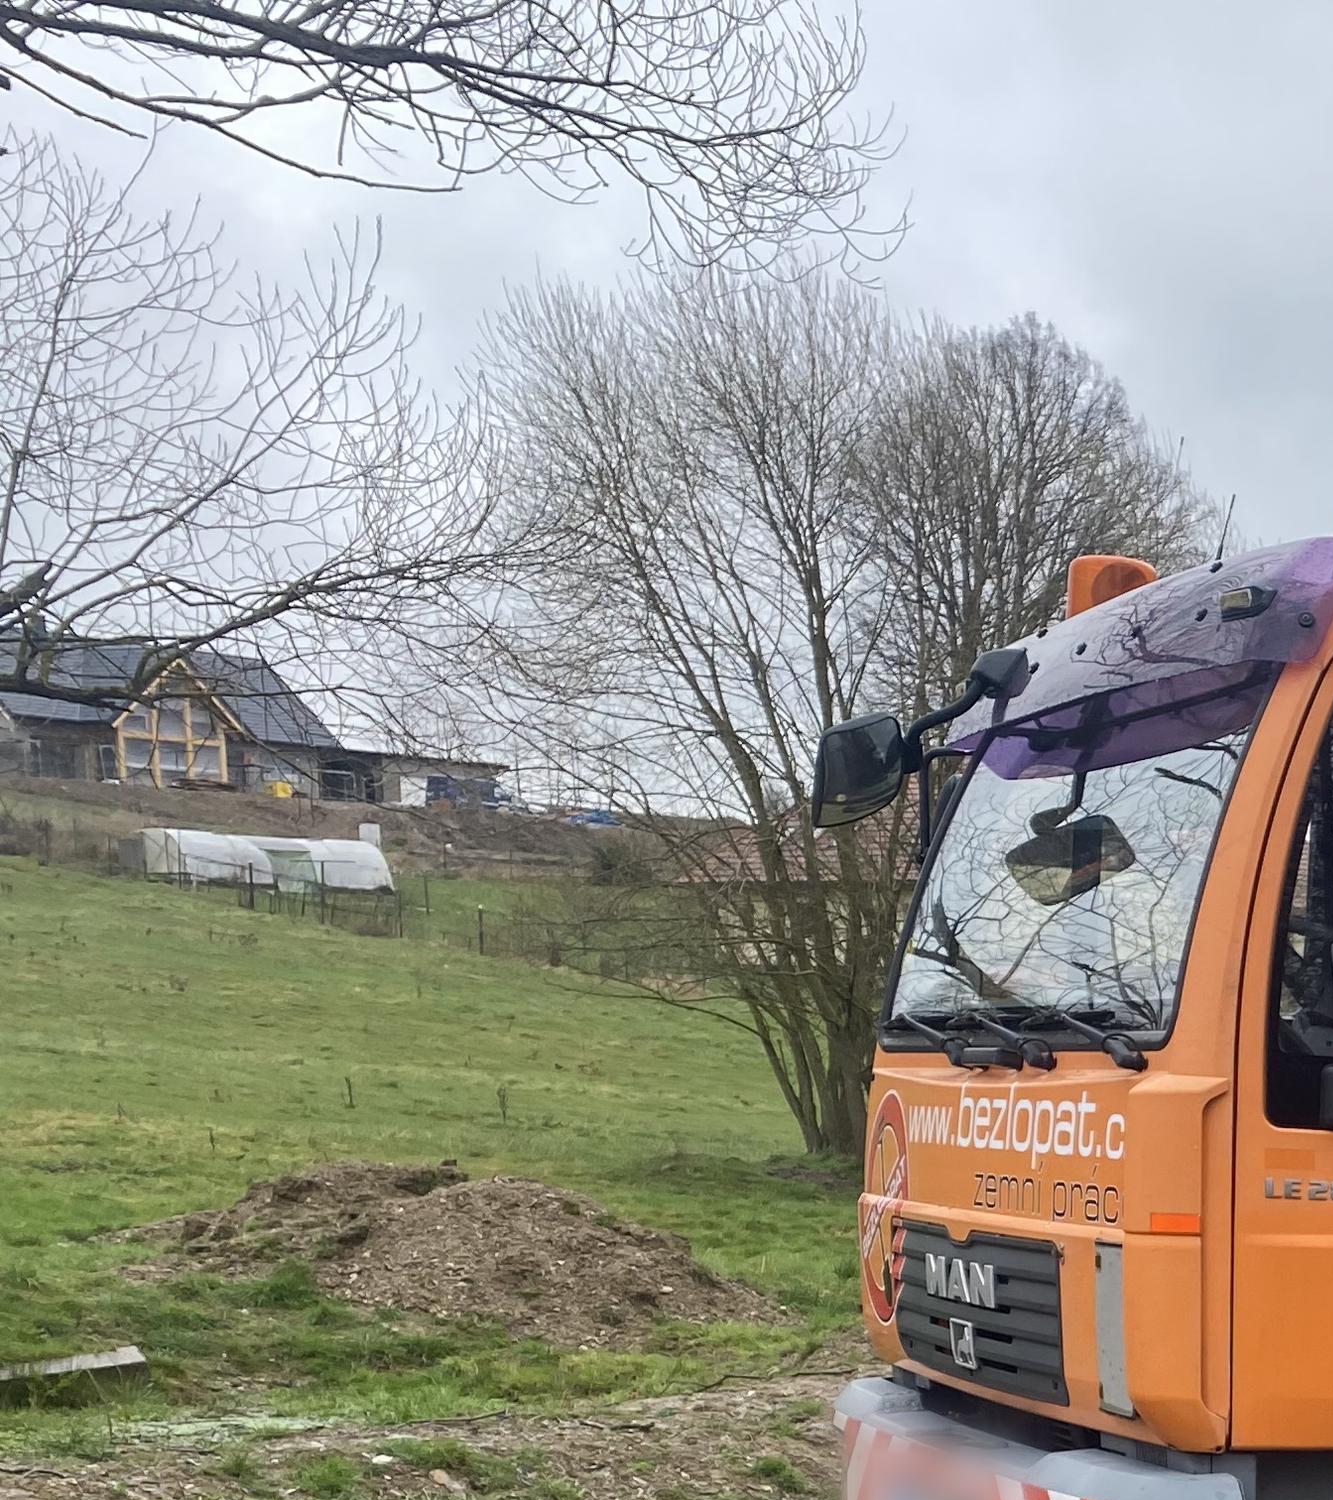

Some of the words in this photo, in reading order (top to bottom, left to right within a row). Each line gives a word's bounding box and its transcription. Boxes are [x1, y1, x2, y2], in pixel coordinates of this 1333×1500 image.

[973, 1160, 1045, 1214] zemní
[1053, 1163, 1125, 1224] prác
[1265, 1176, 1302, 1200] LE
[925, 1253, 996, 1309] MAN
